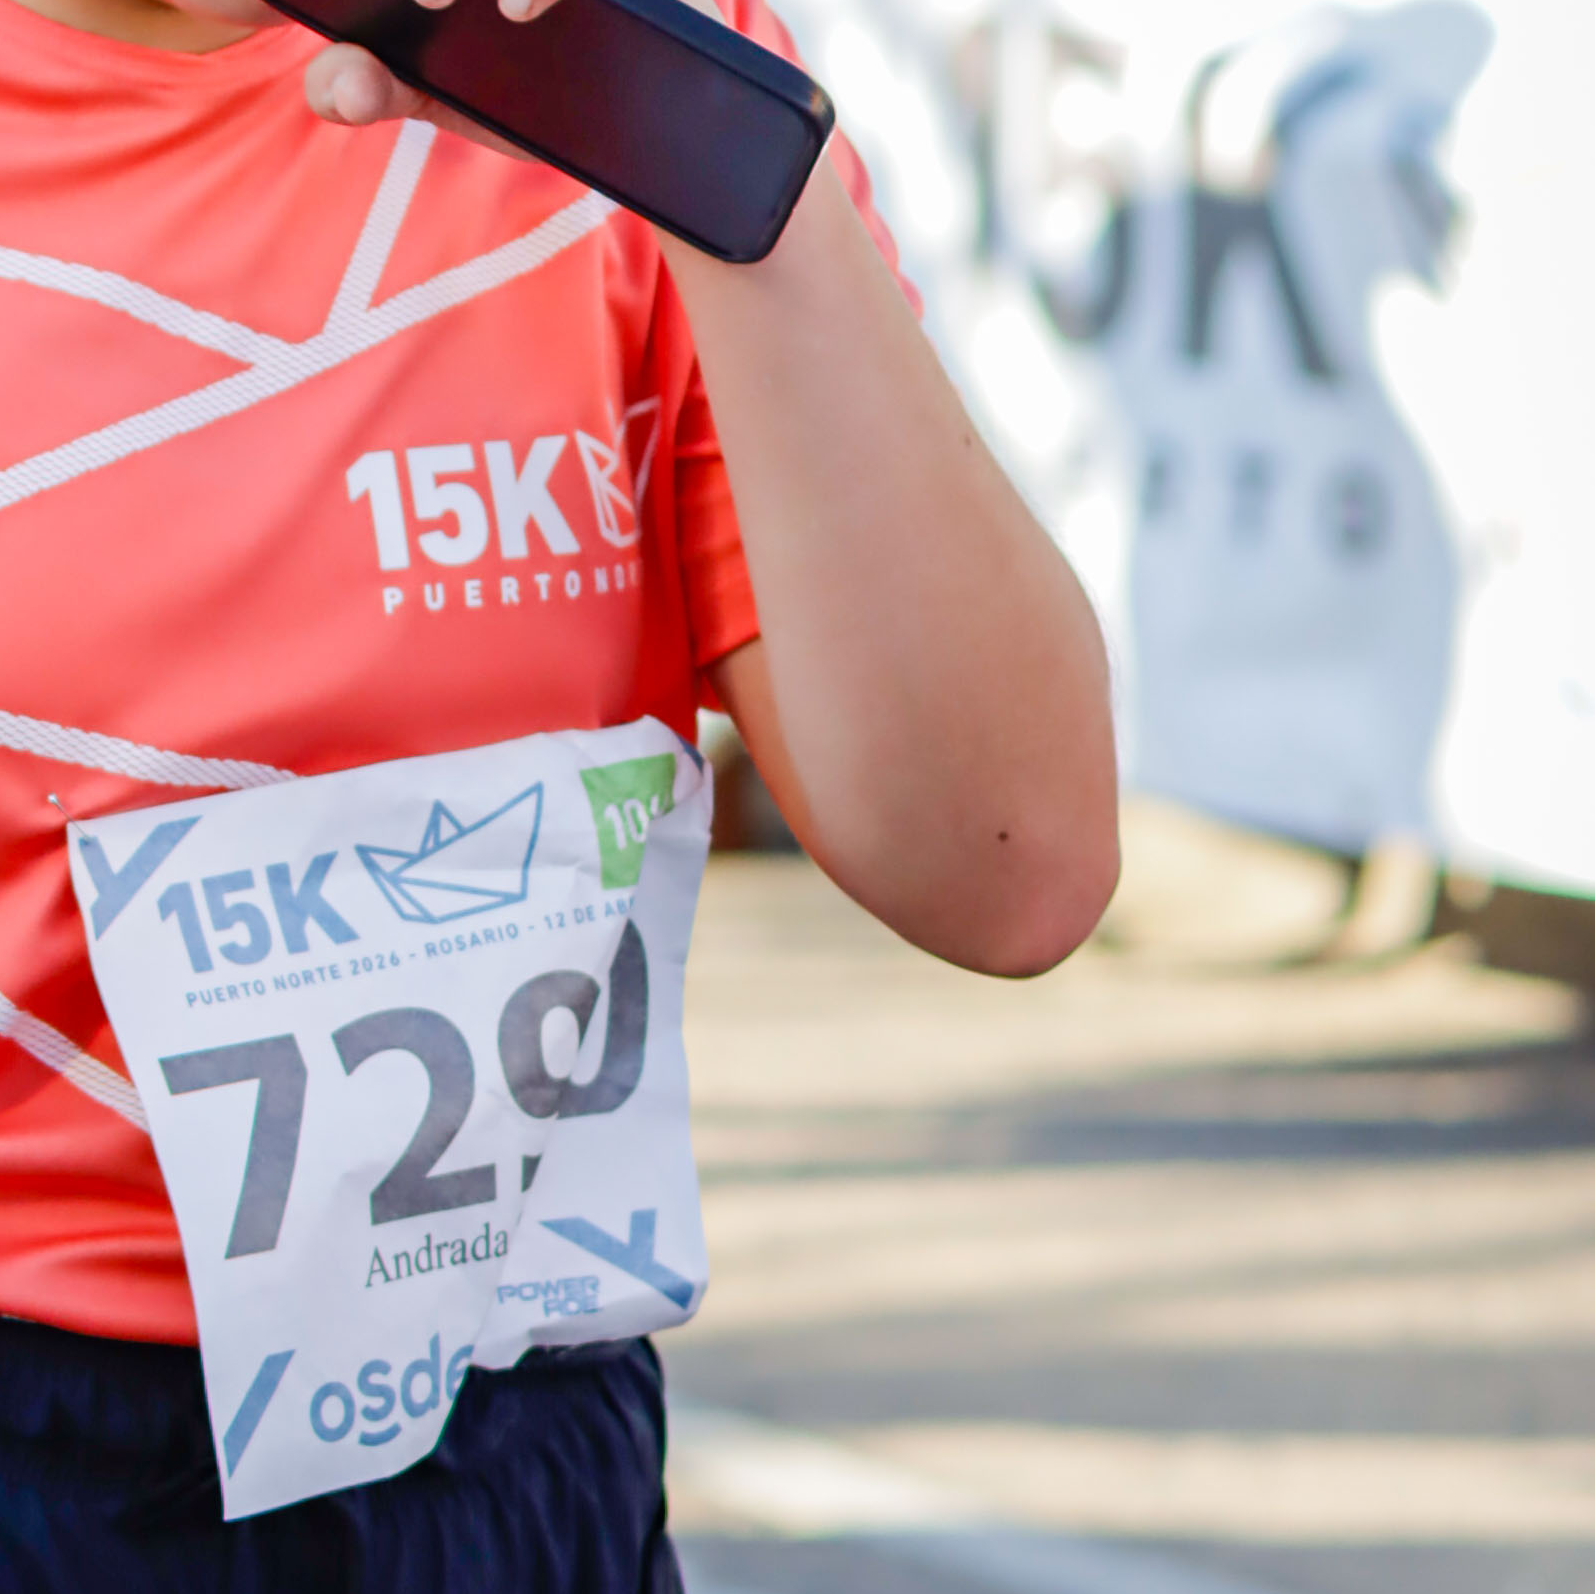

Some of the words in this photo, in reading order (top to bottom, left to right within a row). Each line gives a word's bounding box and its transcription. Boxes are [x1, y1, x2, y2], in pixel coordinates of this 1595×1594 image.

[346, 434, 581, 571] 15K
[382, 569, 581, 615] PUERTO
[157, 850, 360, 973] 15K
[185, 979, 266, 1007] PUERTO
[273, 963, 342, 991] NORTE
[424, 922, 519, 958] ROSARIO
[544, 911, 566, 930] 12
[573, 904, 596, 924] DE
[365, 1221, 508, 1288] Andrada
[496, 1275, 600, 1303] POWER
